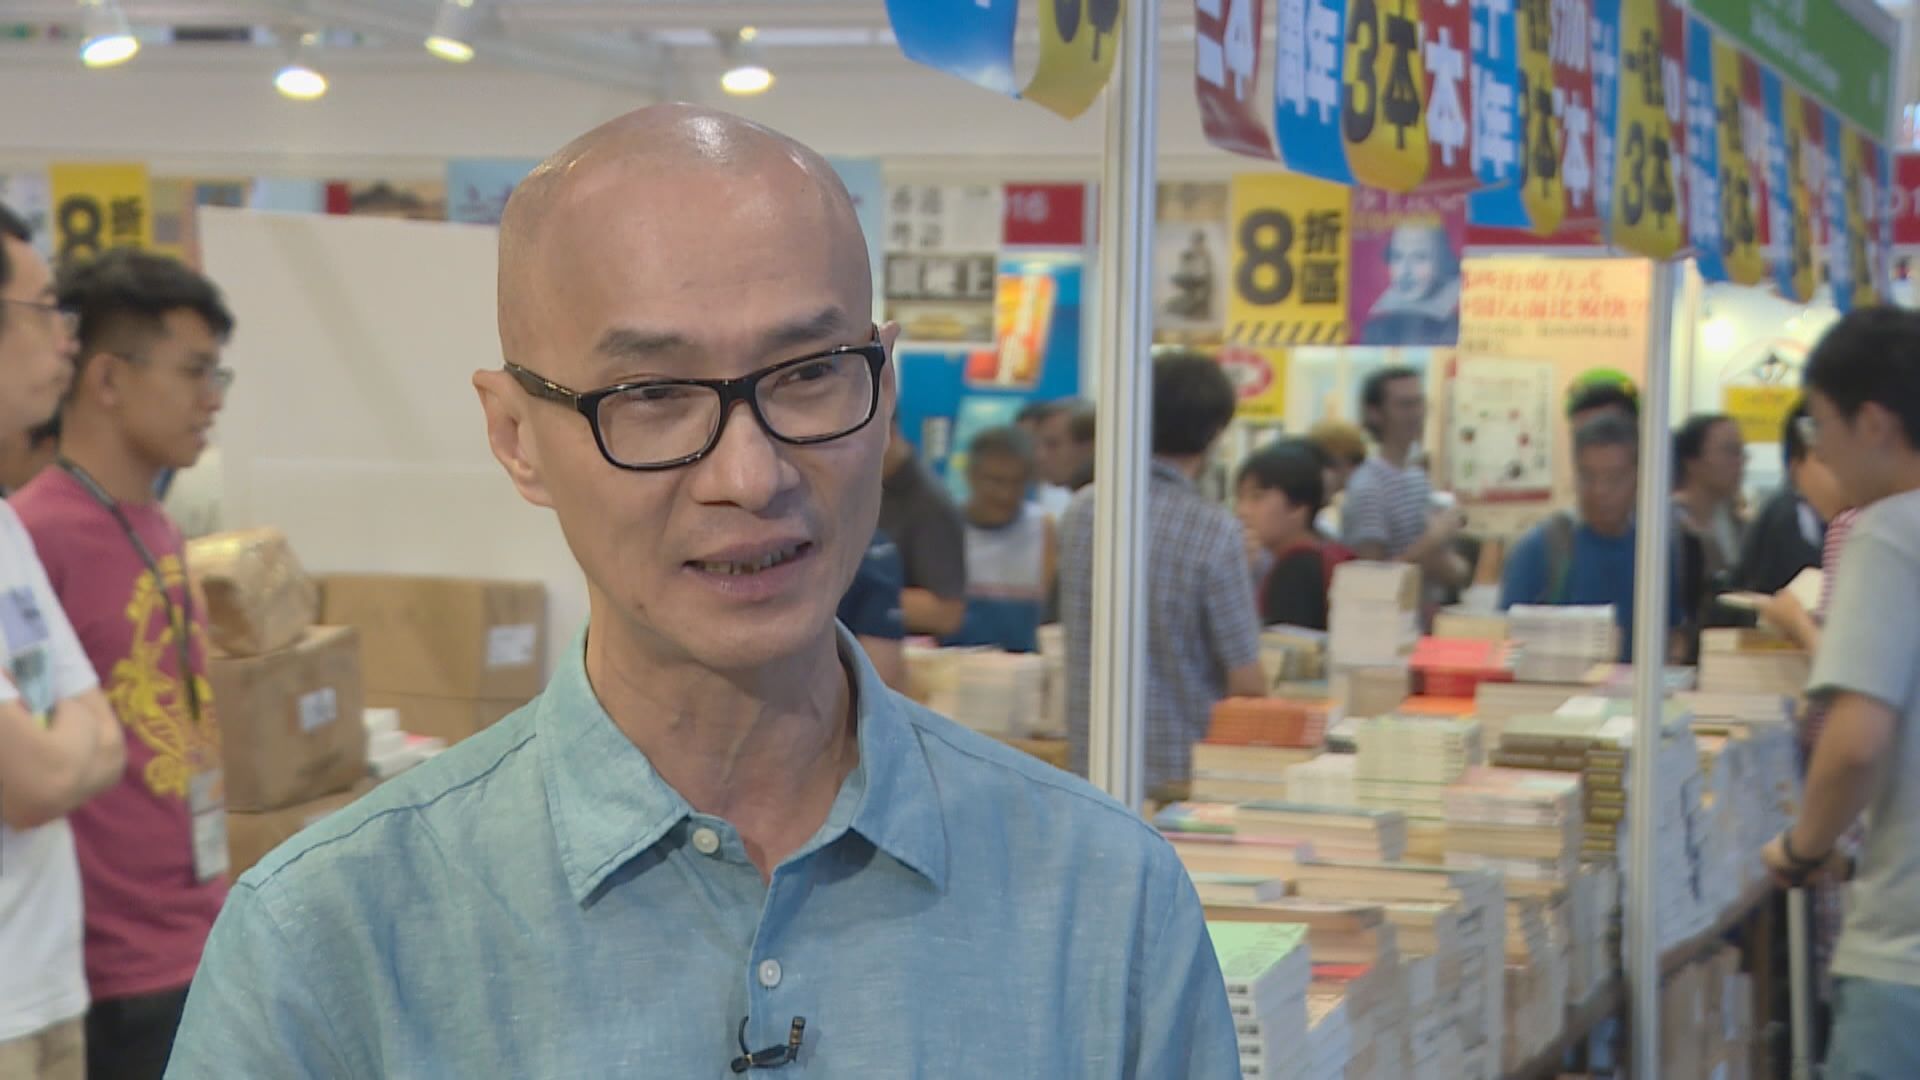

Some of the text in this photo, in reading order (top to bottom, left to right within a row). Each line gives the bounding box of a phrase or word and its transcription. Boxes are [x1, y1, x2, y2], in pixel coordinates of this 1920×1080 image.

[1622, 120, 1673, 230] 3本
[1237, 208, 1296, 305] 8
[1301, 211, 1343, 304] 折區
